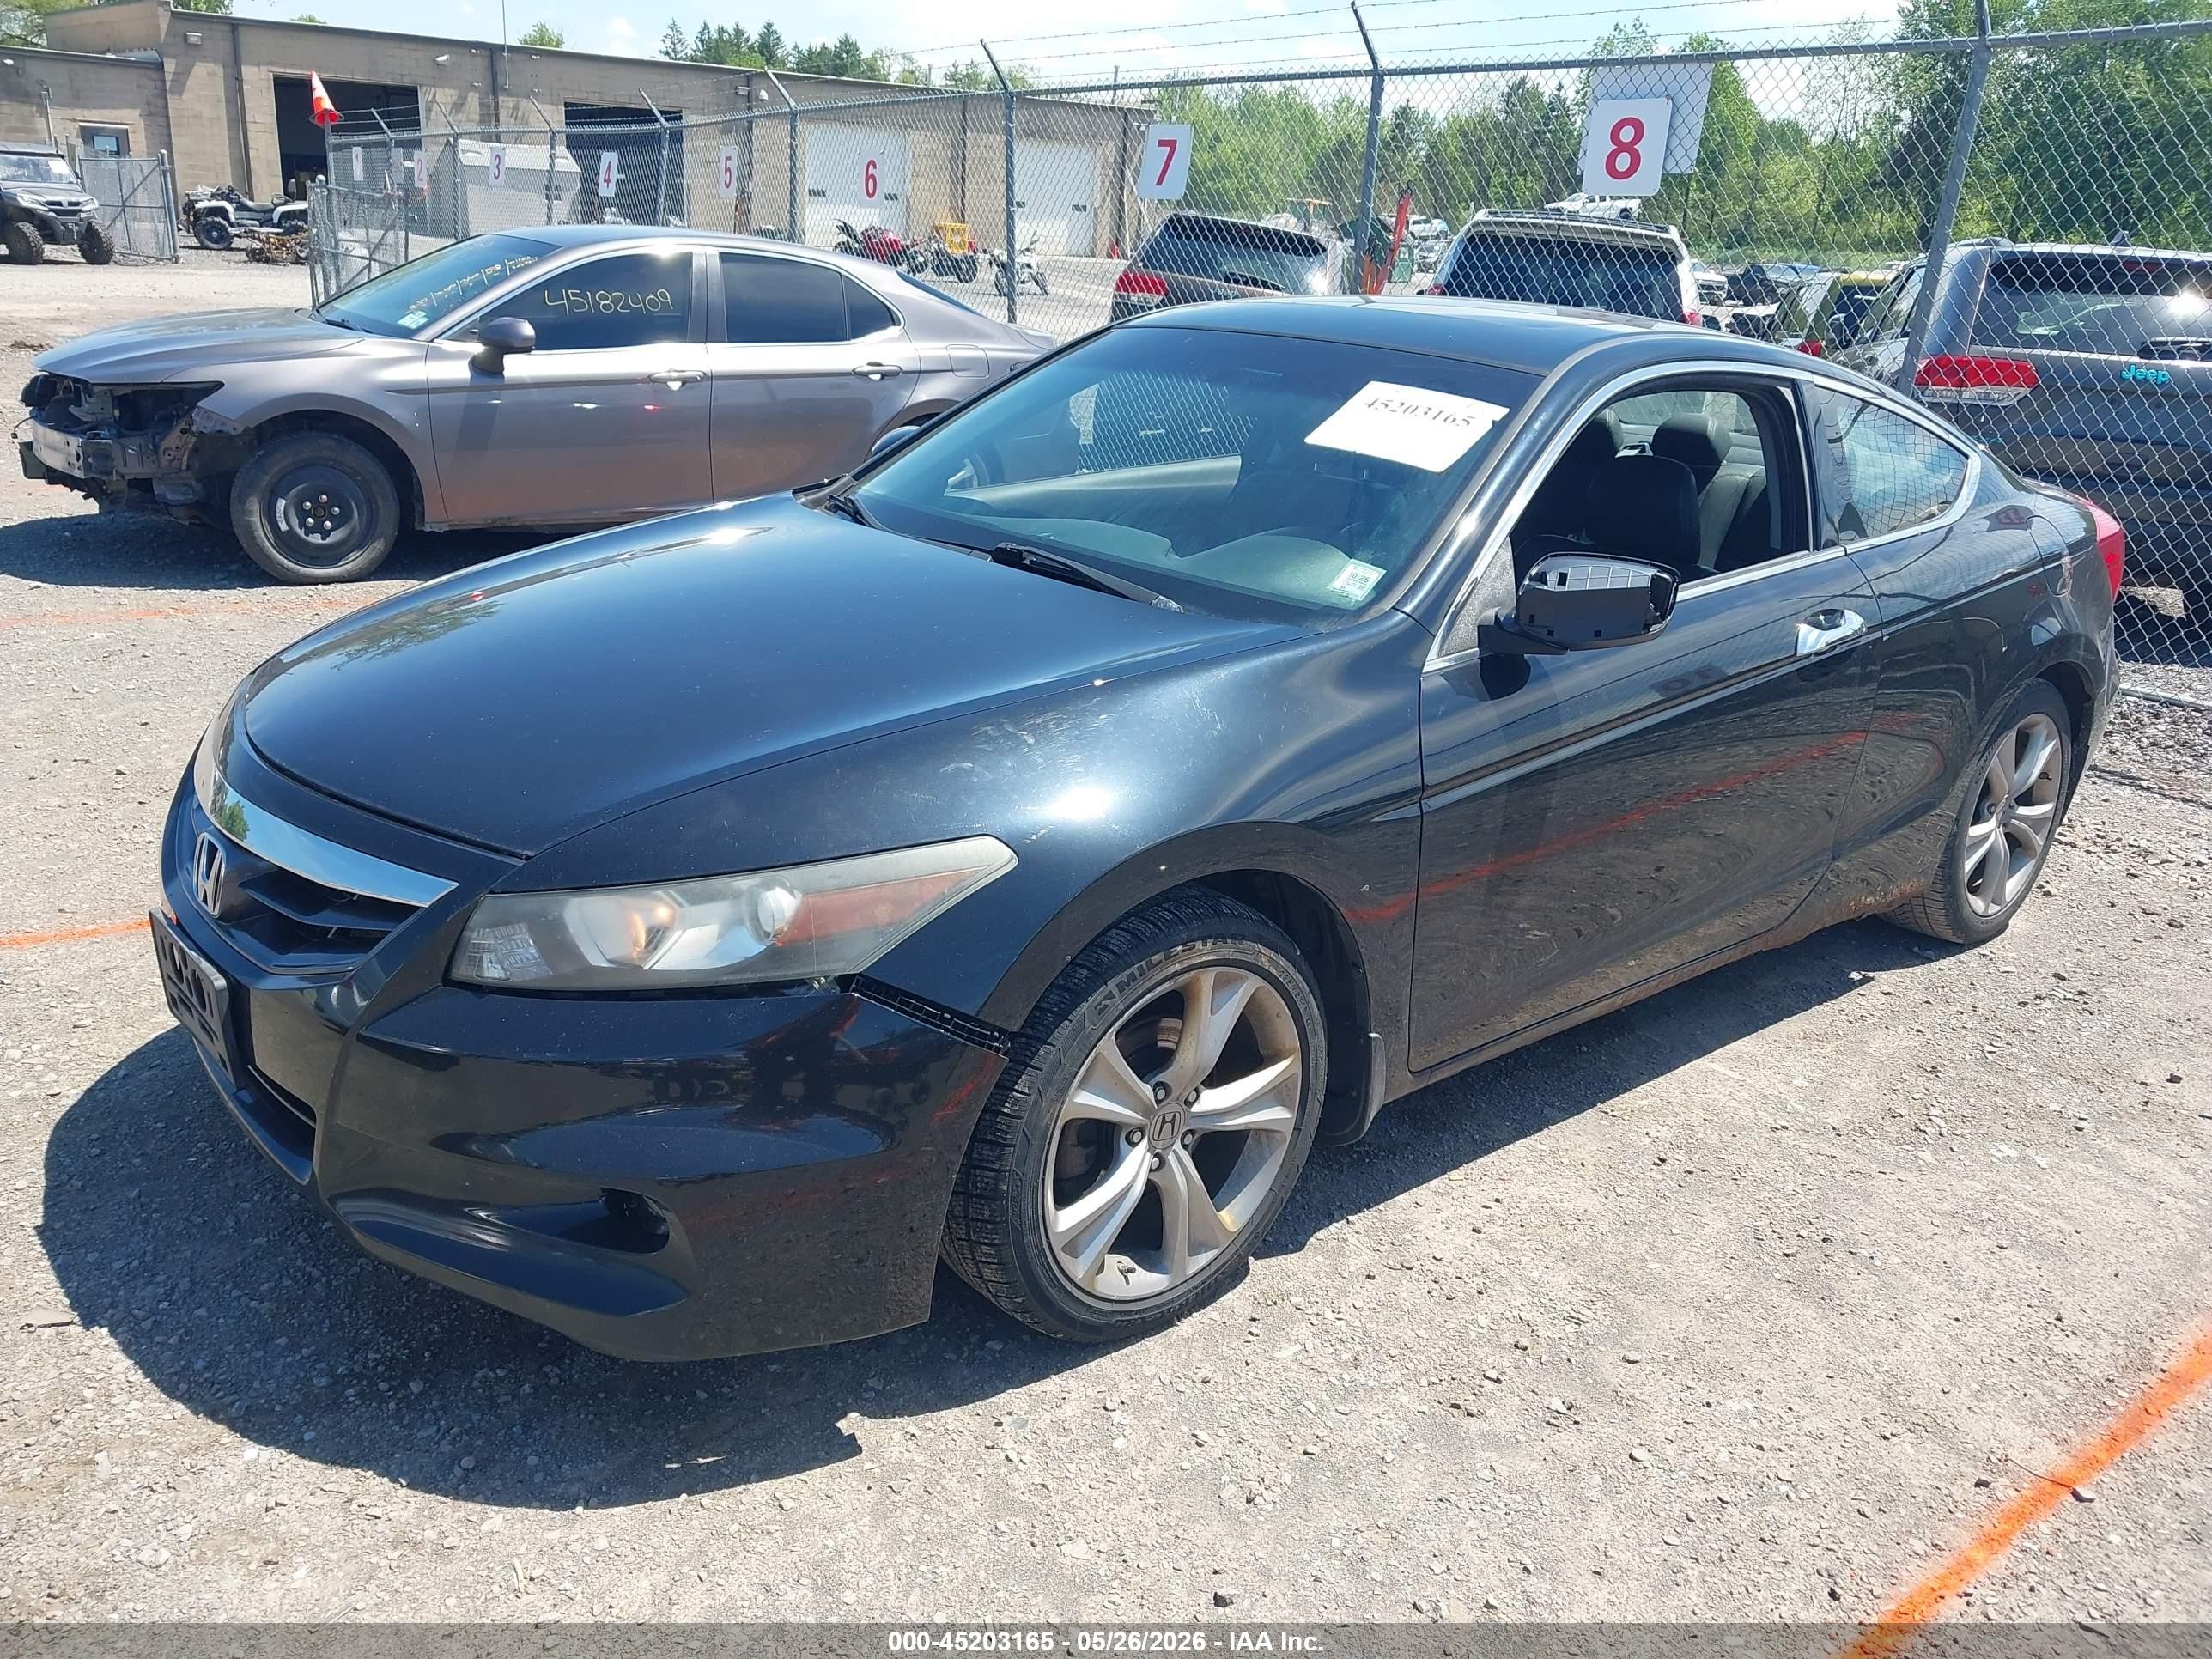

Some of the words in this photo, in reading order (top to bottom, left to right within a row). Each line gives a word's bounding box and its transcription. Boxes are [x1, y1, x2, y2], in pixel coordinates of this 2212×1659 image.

[1155, 139, 1177, 186] 7
[1605, 117, 1645, 180] 8
[416, 158, 424, 181] 2
[493, 154, 501, 179] 3
[603, 161, 612, 188] 4
[724, 155, 732, 189] 5
[865, 159, 878, 199] 6
[544, 288, 674, 316] 45182409
[2120, 364, 2170, 384] Jeep
[1363, 398, 1477, 427] 45203165
[1117, 933, 1248, 994] MILESTAR
